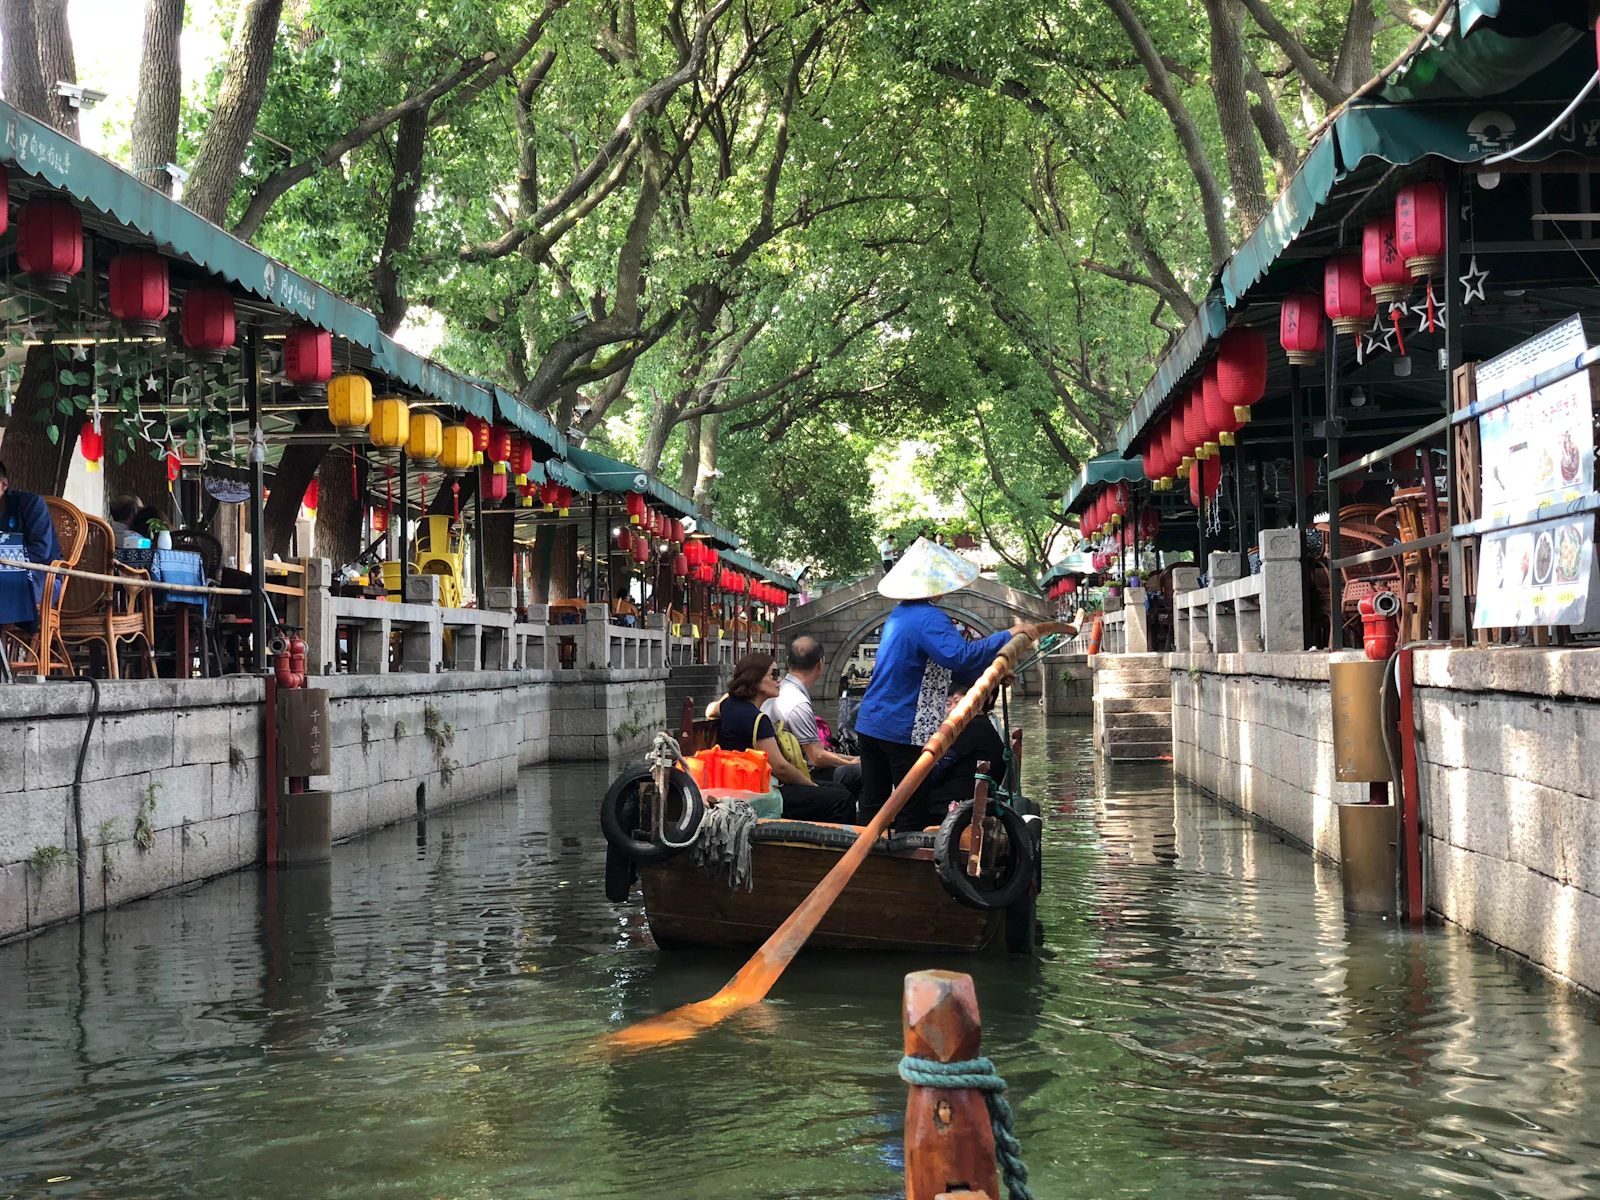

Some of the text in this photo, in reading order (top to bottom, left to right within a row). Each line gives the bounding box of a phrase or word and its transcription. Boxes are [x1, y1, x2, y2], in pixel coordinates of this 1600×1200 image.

[1382, 230, 1398, 264] 茶
[309, 709, 321, 770] 千年古镇
[1339, 693, 1357, 773] 世界同里
